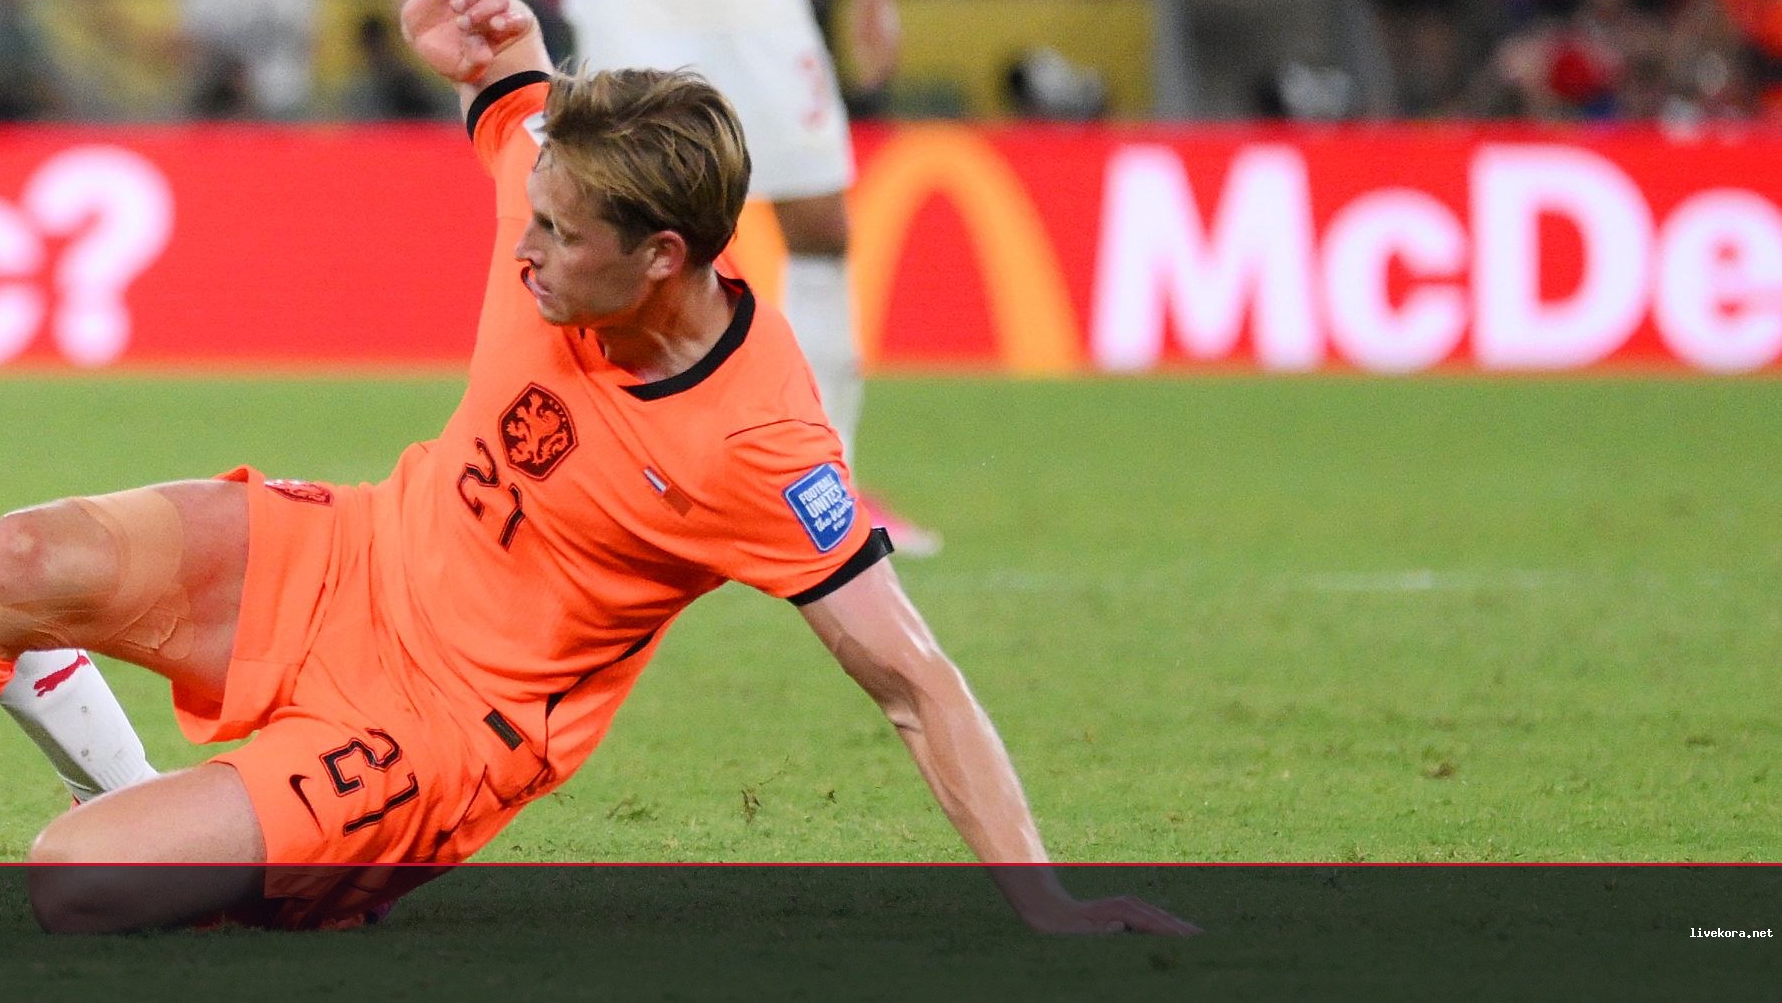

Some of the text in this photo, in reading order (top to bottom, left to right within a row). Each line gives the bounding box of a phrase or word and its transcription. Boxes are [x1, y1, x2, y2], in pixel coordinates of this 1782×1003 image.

[457, 437, 526, 553] 21
[806, 484, 842, 518] UNITES
[319, 727, 419, 836] 21
